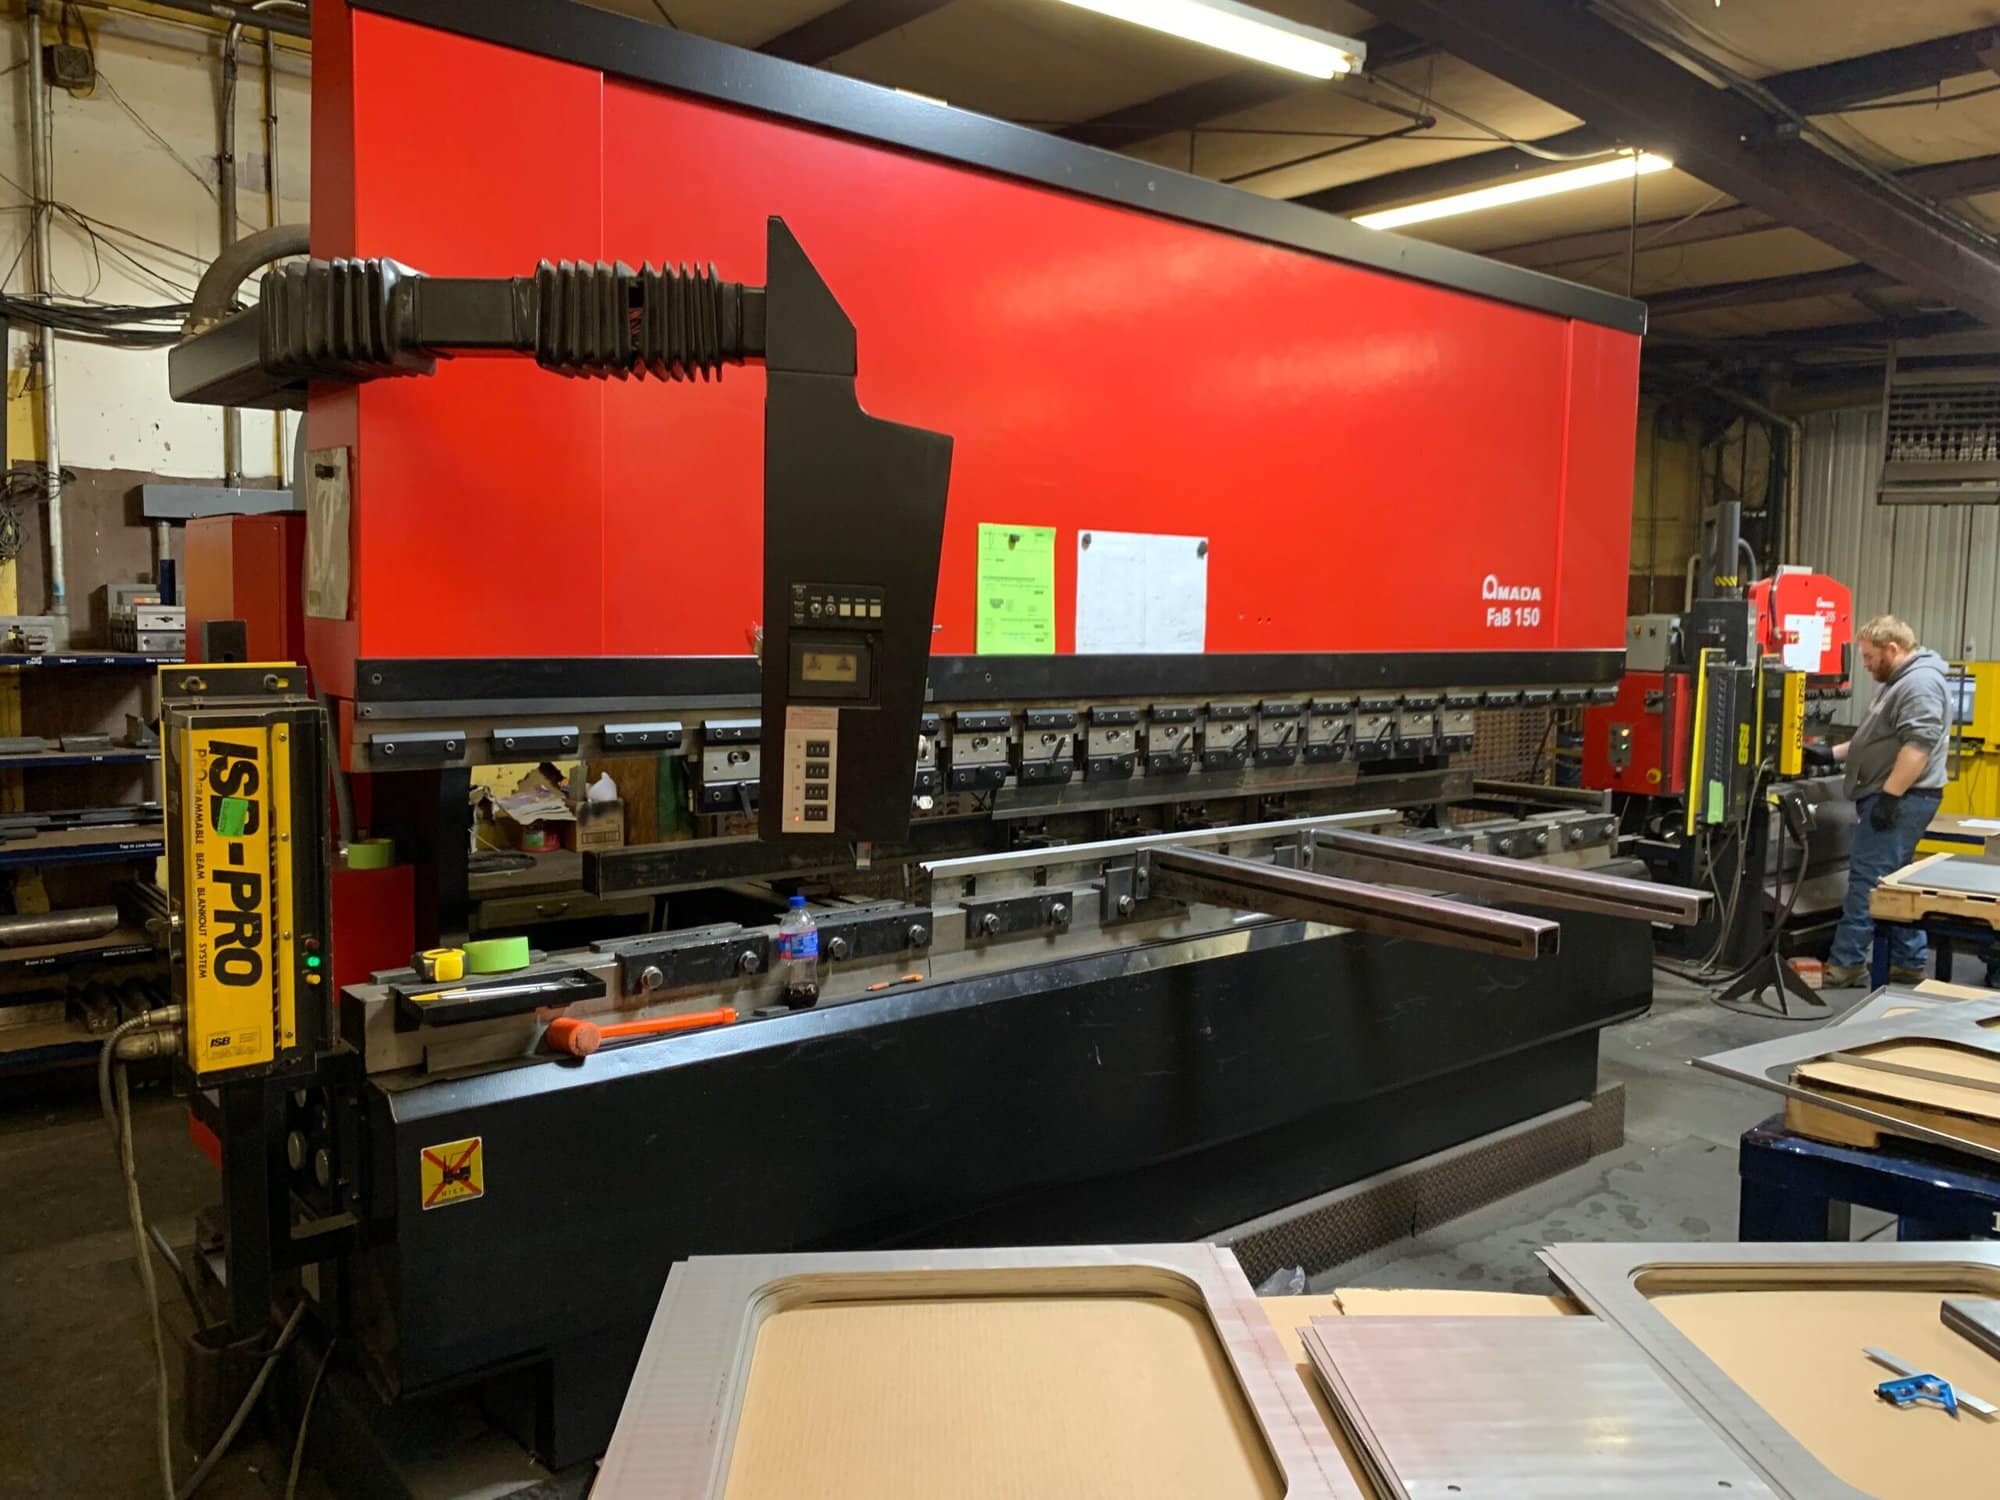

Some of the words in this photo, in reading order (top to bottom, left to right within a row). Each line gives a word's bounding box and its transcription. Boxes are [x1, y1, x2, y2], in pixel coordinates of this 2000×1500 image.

[1482, 574, 1542, 601] AMADA
[1486, 607, 1511, 628] FaB
[1514, 607, 1541, 628] 150
[196, 852, 205, 879] BEAM
[197, 887, 207, 937] BLANKOUT
[198, 943, 207, 979] SYSTEM
[209, 1036, 231, 1048] ISB
